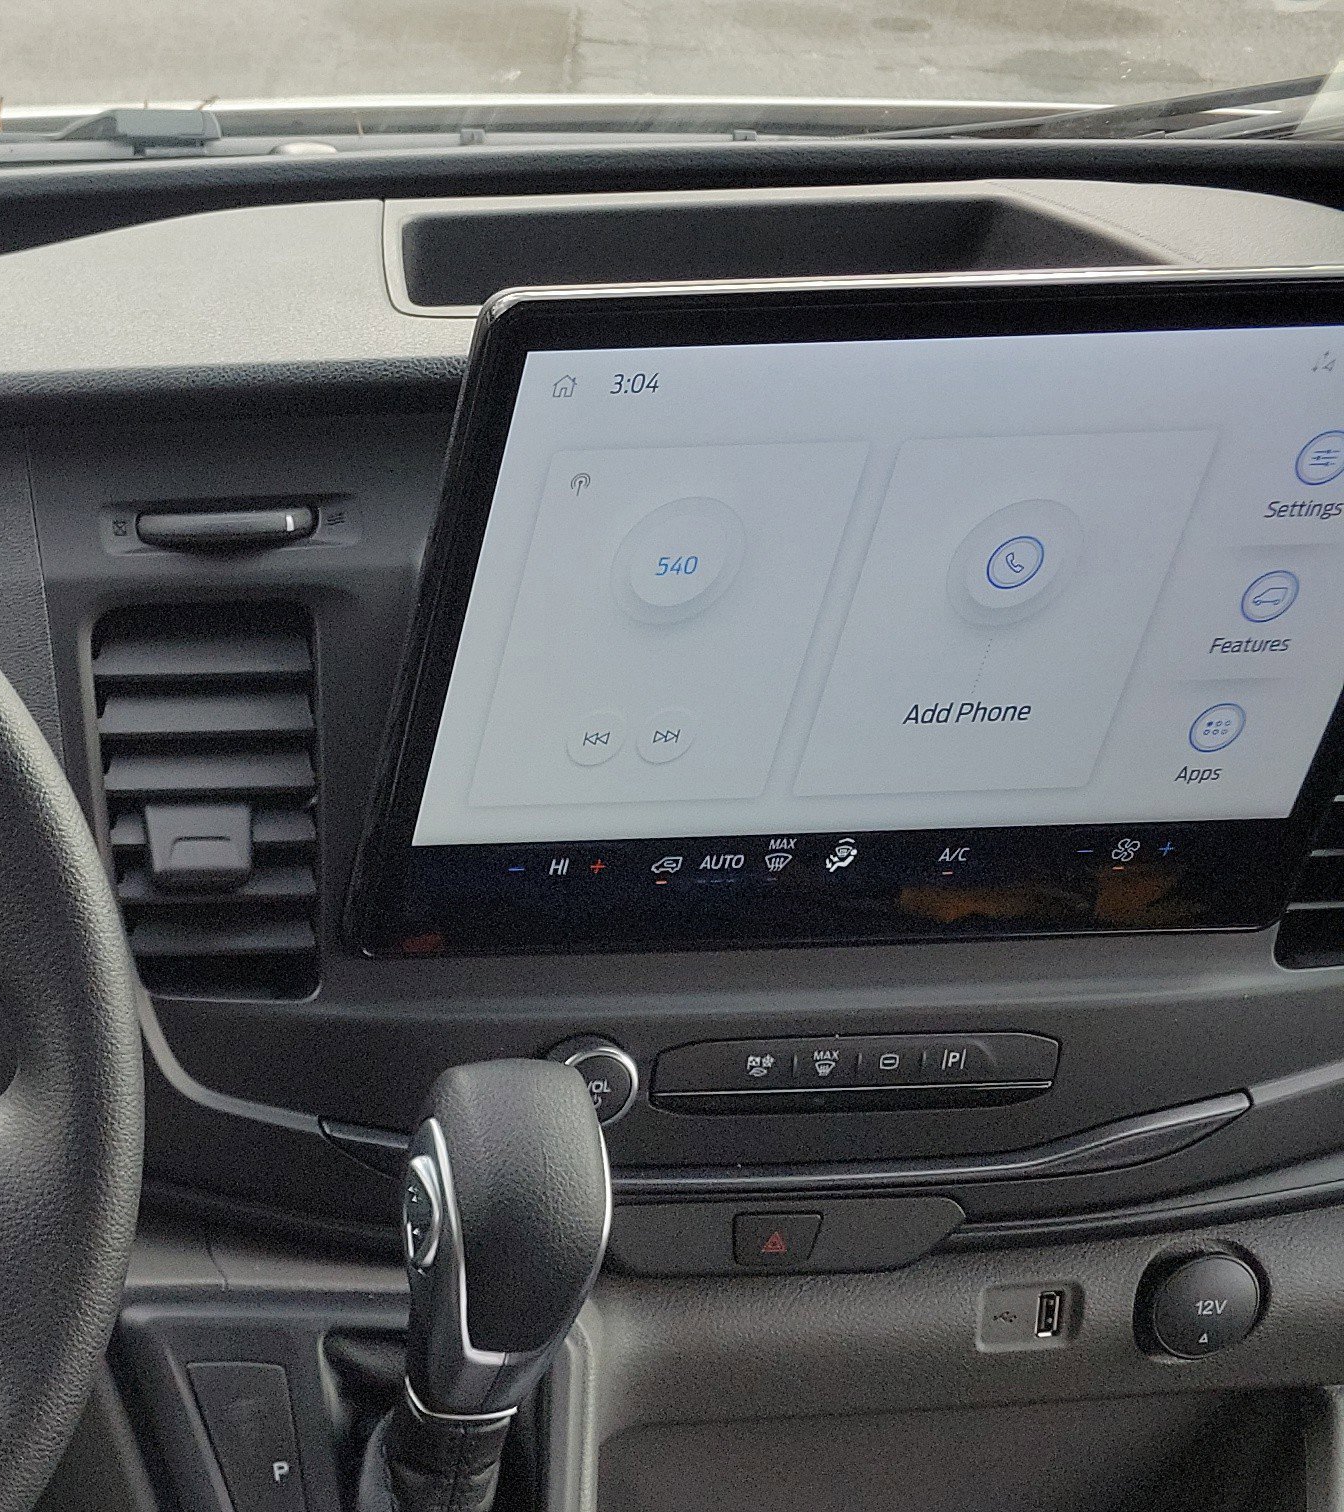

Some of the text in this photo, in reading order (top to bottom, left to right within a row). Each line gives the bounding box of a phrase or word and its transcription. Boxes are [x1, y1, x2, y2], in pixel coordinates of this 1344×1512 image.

[610, 372, 659, 395] 3:04
[1264, 499, 1344, 520] Settings
[655, 555, 699, 576] 540
[1209, 636, 1292, 654] Features
[902, 701, 1032, 725] Add Phone
[1174, 765, 1222, 784] Apps
[768, 837, 798, 850] MAX
[698, 853, 745, 870] AUTO
[938, 847, 971, 862] A/C
[548, 857, 570, 876] HI
[812, 1050, 840, 1061] MAX
[1194, 1299, 1228, 1316] 12V
